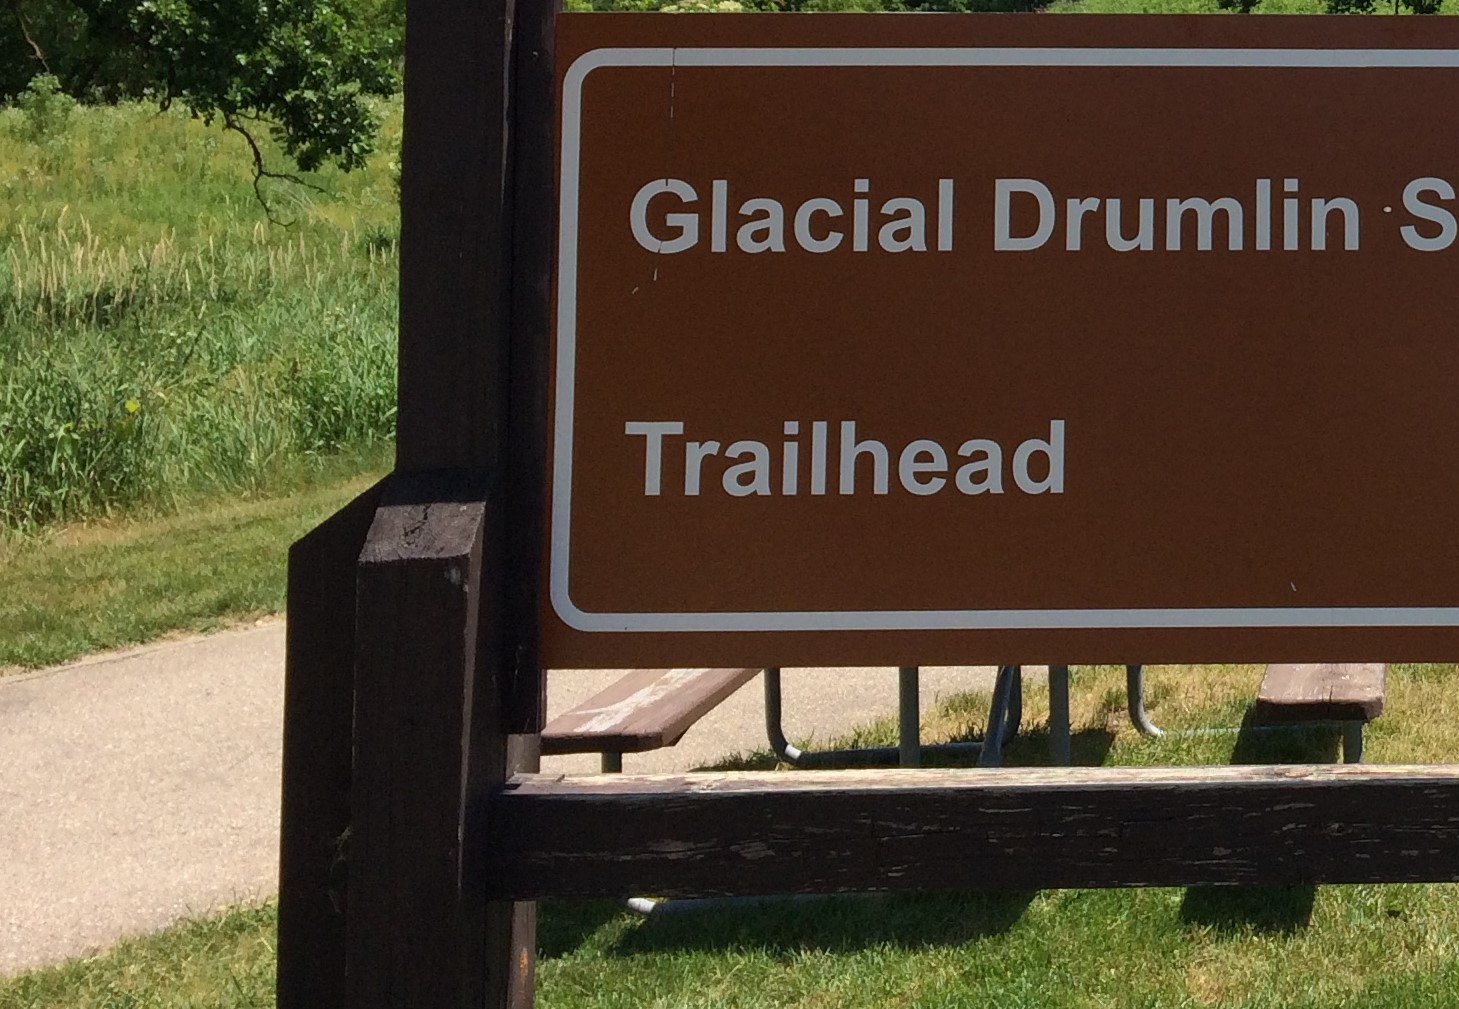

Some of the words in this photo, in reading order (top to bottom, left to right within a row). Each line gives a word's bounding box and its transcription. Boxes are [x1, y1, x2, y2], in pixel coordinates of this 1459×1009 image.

[629, 178, 954, 254] Glacial
[993, 178, 1360, 252] Drumlin
[625, 420, 1065, 497] Trailhead
